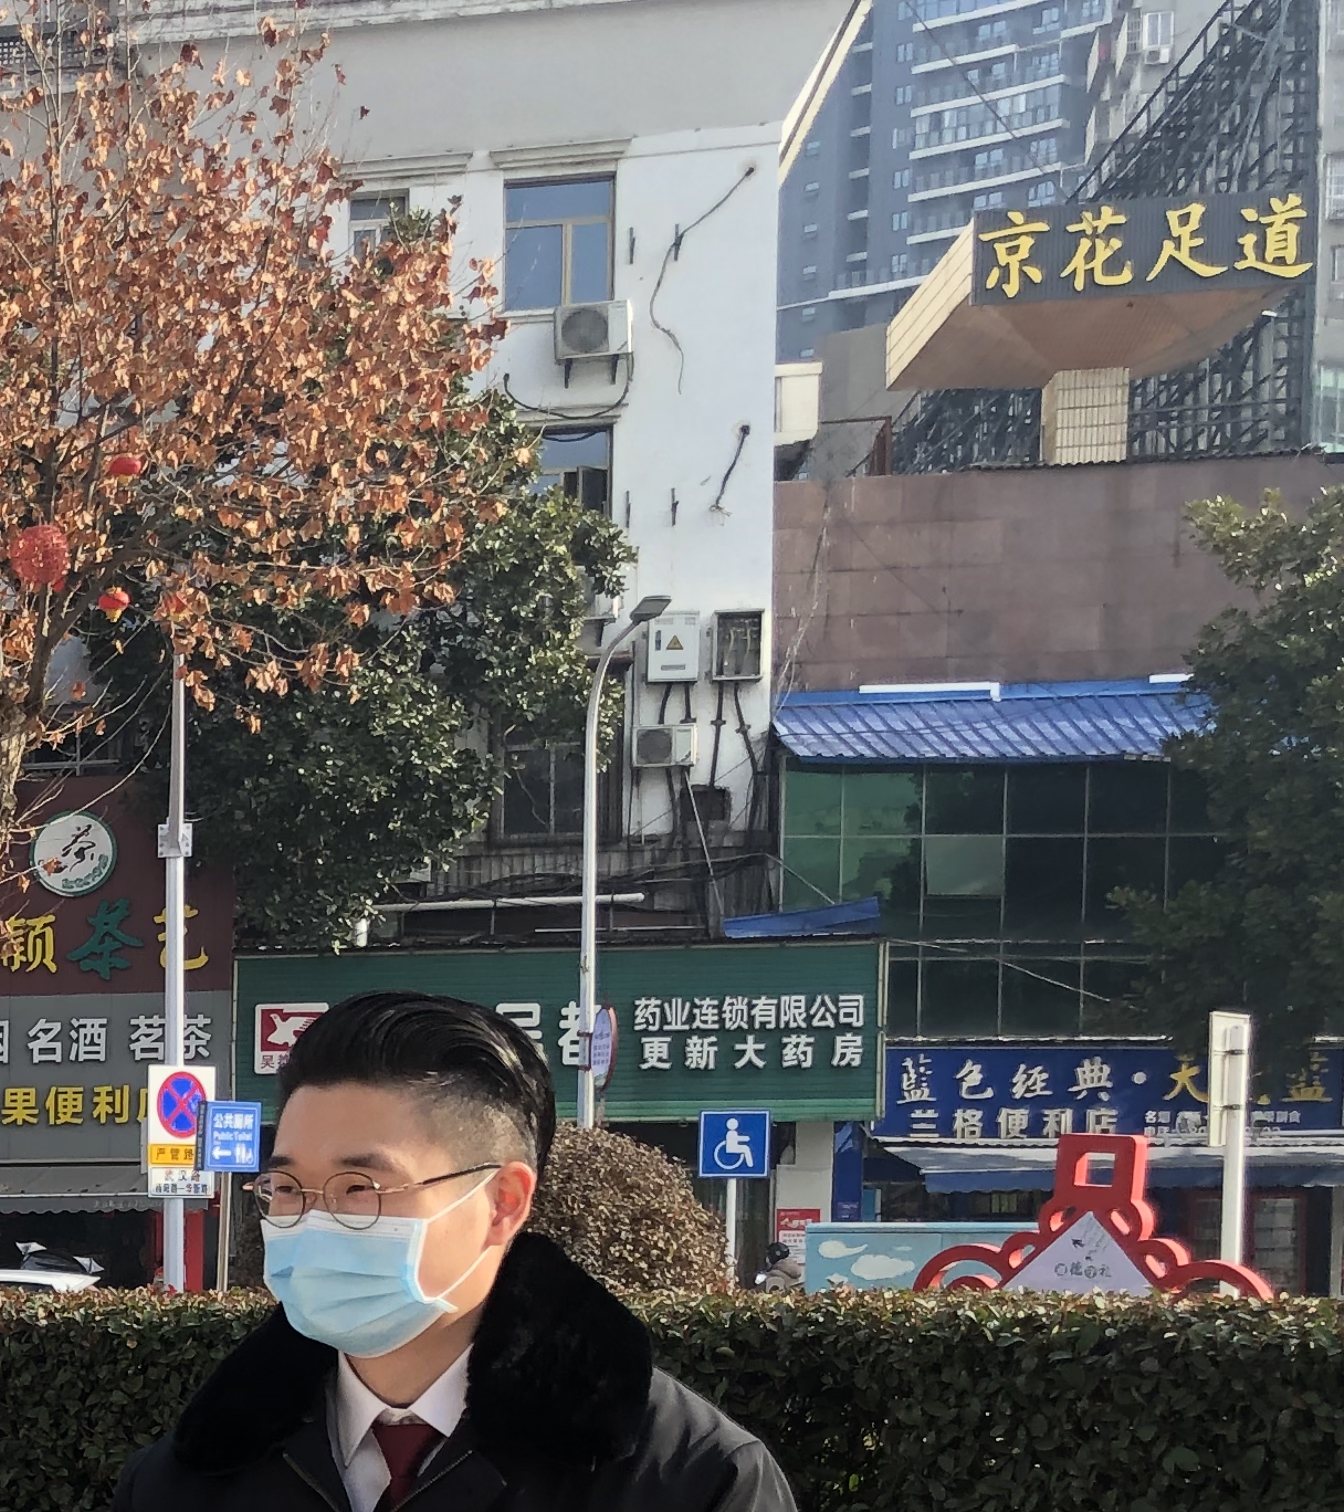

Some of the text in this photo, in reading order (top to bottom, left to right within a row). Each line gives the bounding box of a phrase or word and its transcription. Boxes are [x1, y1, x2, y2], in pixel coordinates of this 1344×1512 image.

[978, 193, 1313, 298] 京花足道
[633, 994, 866, 1031] 药业连锁有限公司
[28, 1017, 109, 1065] 名酒
[640, 1034, 865, 1071] 更新大药房
[213, 1112, 254, 1131] 公共厕所
[908, 1108, 1119, 1139] 兰格便利店
